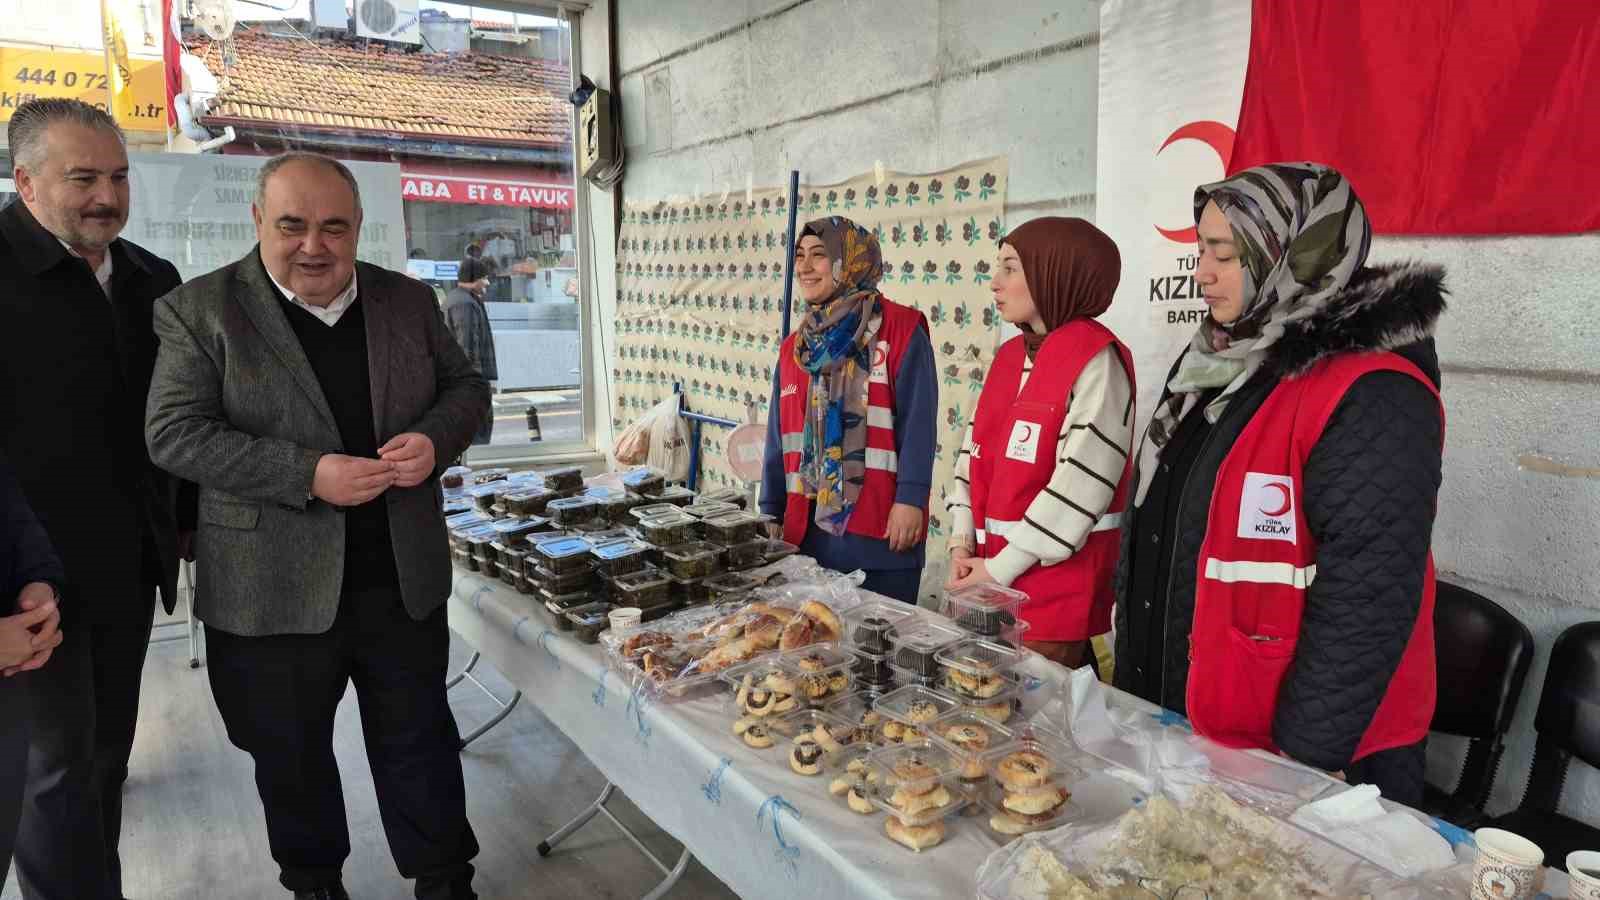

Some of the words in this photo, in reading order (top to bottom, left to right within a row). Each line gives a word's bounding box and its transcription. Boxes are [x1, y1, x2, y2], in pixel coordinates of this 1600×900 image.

[15, 67, 57, 87] 444
[64, 71, 79, 88] 0
[85, 74, 109, 90] 72
[468, 184, 488, 201] ET
[493, 187, 505, 201] &
[508, 187, 569, 206] TAVUK
[1149, 276, 1205, 303] KIZIL
[1167, 309, 1208, 324] BART
[1255, 524, 1291, 535] KIZILAY
